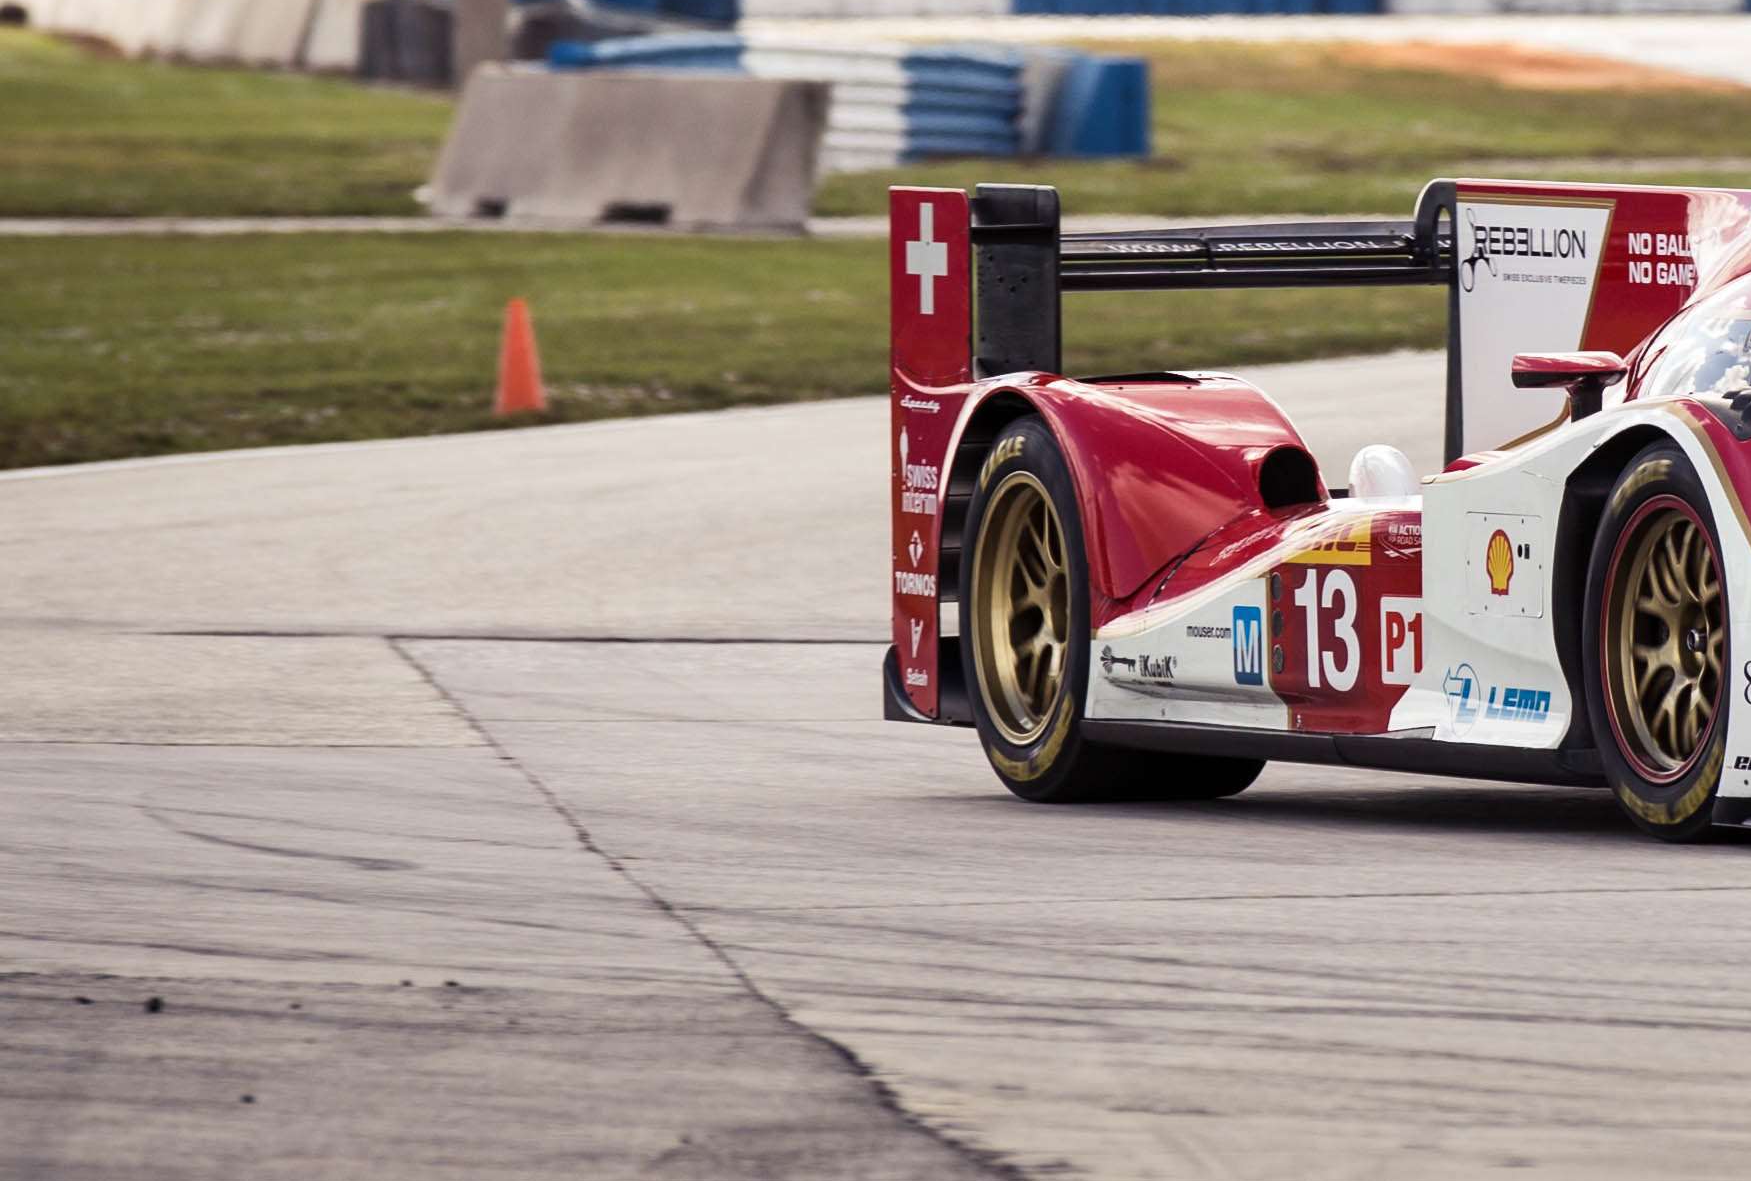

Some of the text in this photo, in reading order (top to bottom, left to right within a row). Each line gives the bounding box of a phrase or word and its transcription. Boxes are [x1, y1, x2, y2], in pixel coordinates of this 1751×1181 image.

[1474, 225, 1586, 259] REBELLION
[1628, 232, 1651, 255] NO
[1628, 261, 1652, 284] NO
[1399, 523, 1422, 536] ACTIO
[895, 570, 937, 597] TORNOS
[1186, 625, 1232, 639] mouser.com
[1294, 568, 1361, 692] 13
[1385, 611, 1422, 674] P1
[1485, 686, 1551, 723] LEMO
